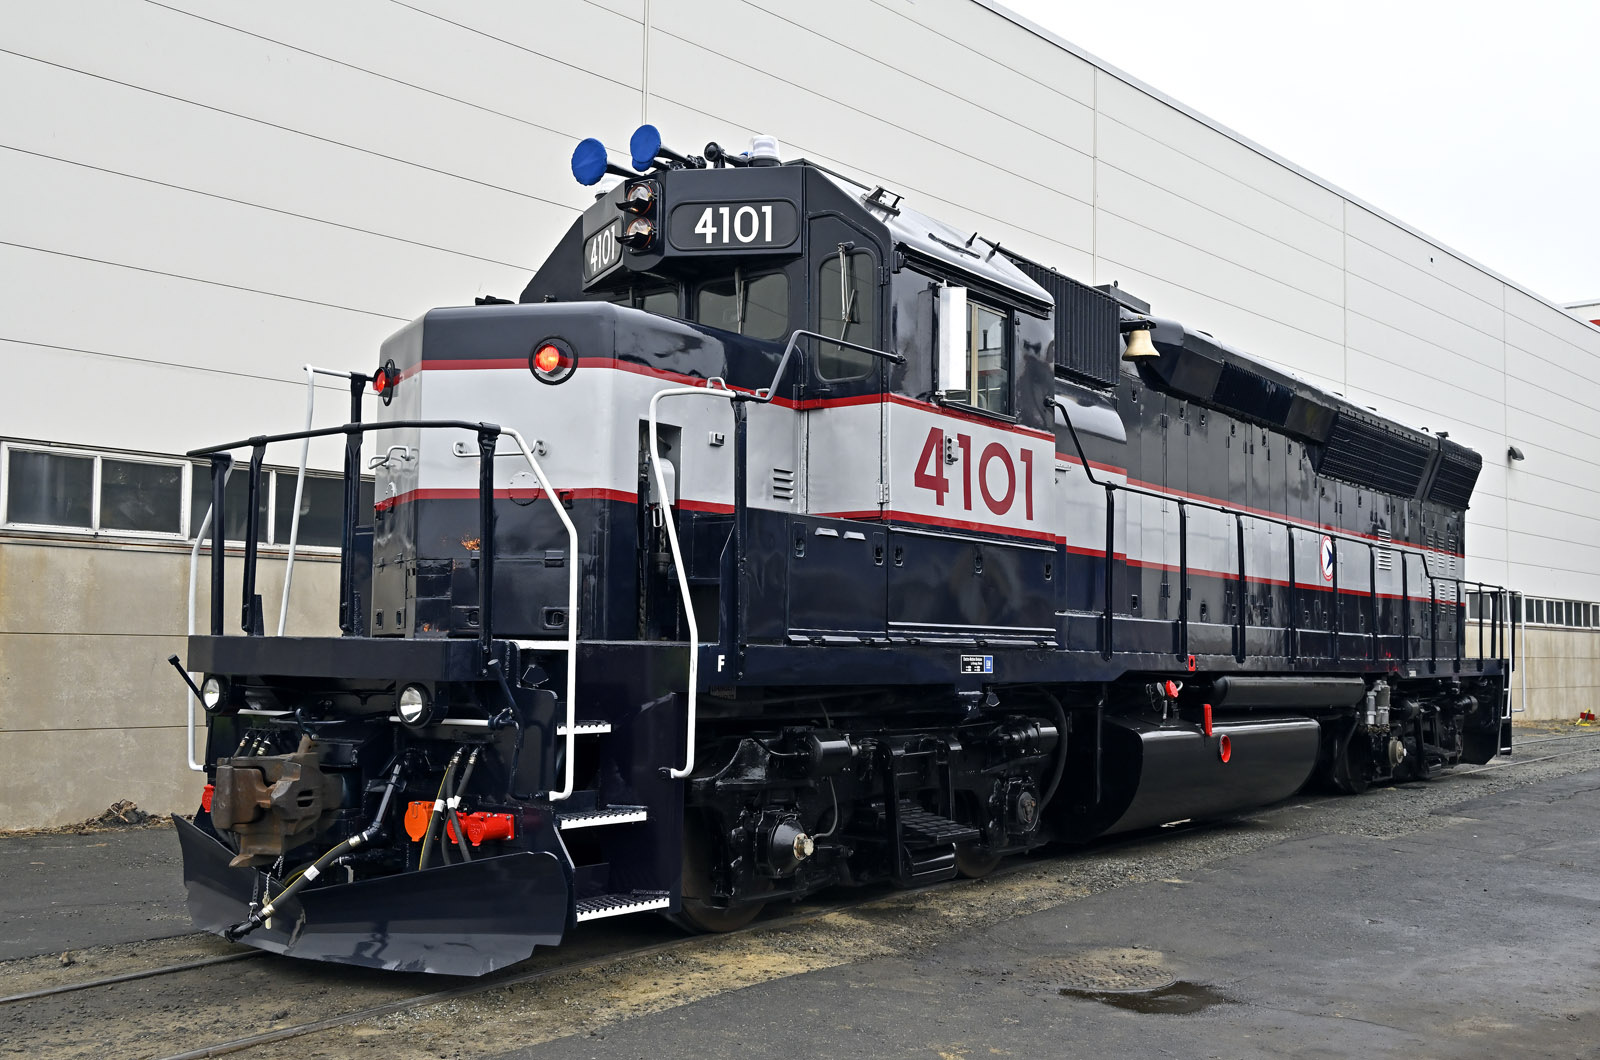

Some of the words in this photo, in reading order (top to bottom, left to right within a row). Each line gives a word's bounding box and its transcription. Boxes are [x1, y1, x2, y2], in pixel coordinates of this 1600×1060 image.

[694, 205, 773, 244] 4101
[590, 225, 615, 272] 4101
[914, 426, 1034, 521] 4101
[717, 654, 726, 672] F
